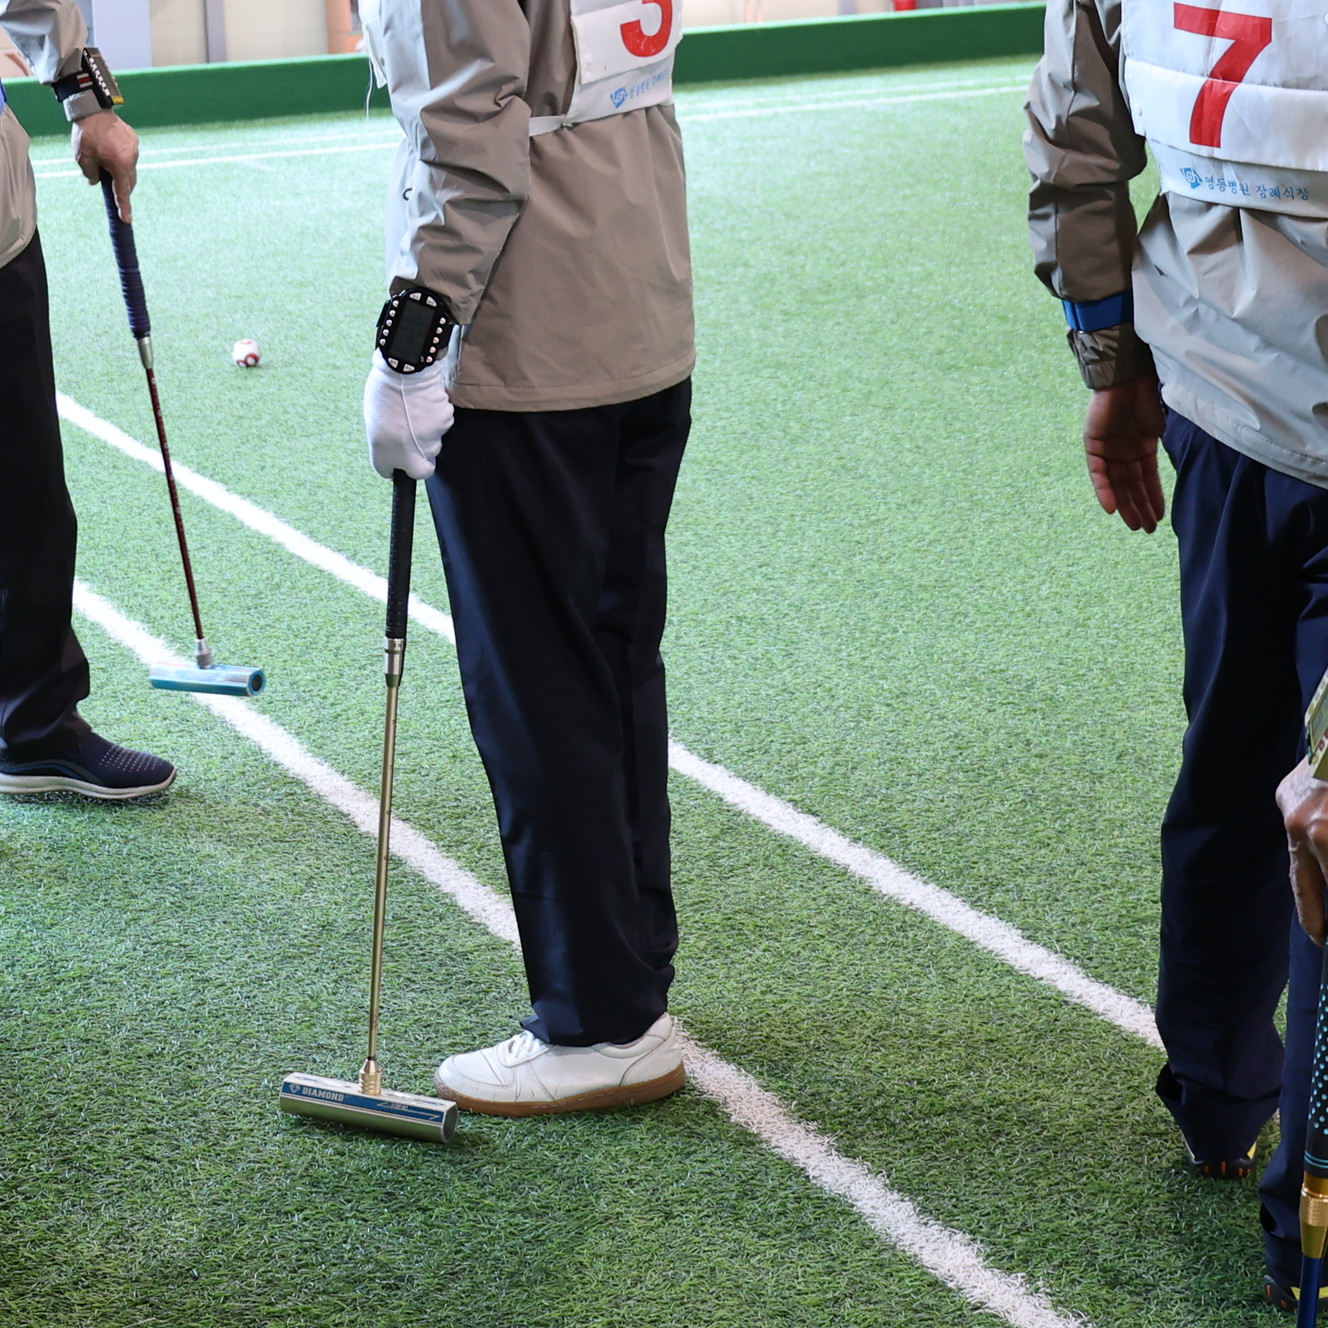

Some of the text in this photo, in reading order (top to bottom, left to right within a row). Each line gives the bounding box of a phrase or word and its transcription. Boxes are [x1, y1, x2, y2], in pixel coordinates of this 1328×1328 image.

[1173, 2, 1273, 149] 7
[1204, 175, 1311, 202] 영동병원 장례식장
[301, 1086, 345, 1102] DIAMOND
